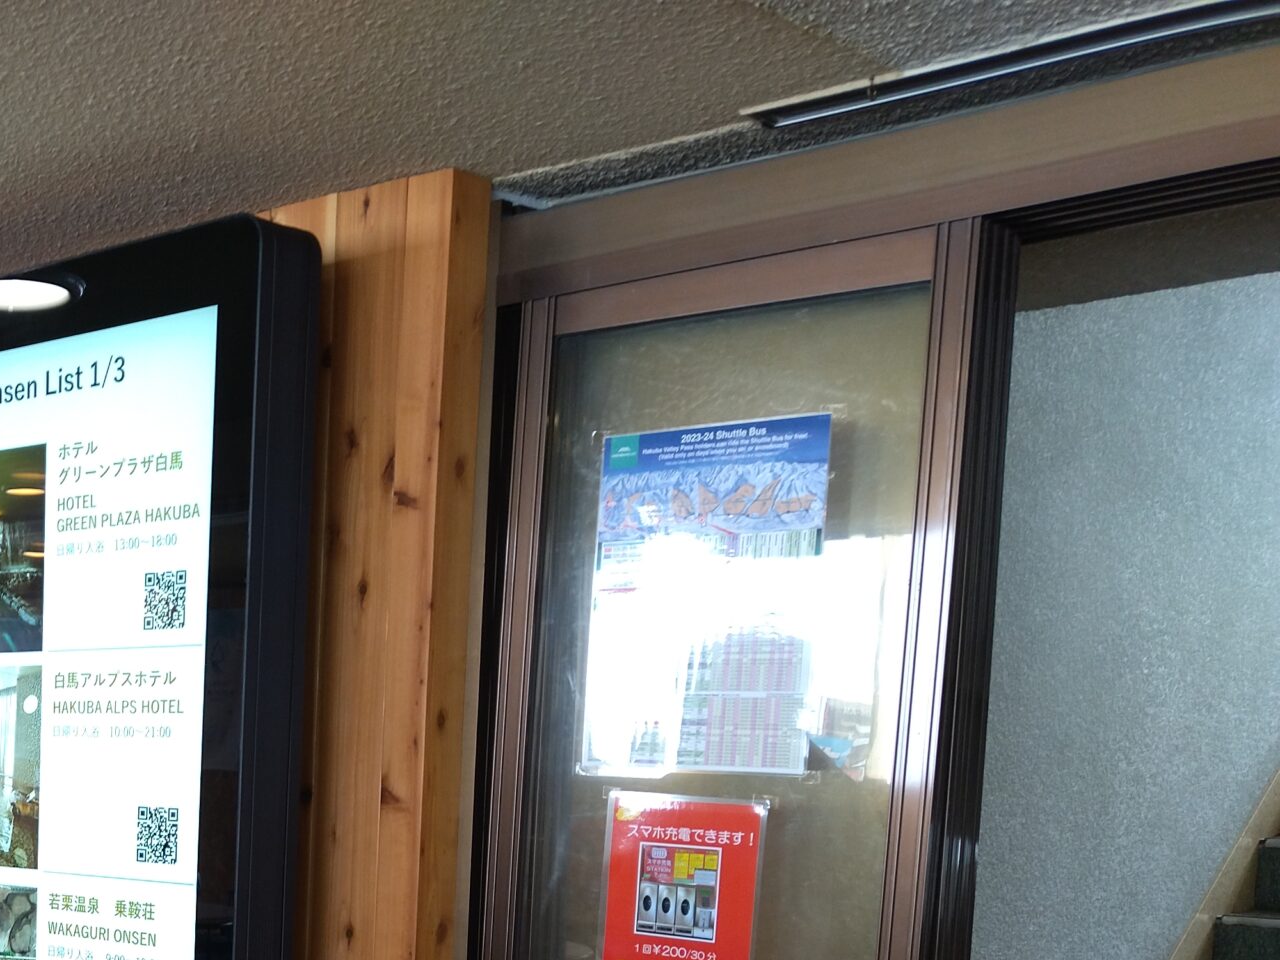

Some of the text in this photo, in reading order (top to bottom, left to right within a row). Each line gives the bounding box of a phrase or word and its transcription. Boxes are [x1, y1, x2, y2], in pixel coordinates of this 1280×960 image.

[45, 366, 83, 396] List
[90, 355, 125, 389] 1/3
[716, 428, 746, 440] Shuttle
[749, 427, 767, 436] Bus
[58, 440, 98, 460] ホテル
[59, 451, 183, 485] グリーンプラザ白馬
[57, 494, 96, 512] HOTEL
[57, 503, 200, 532] GREEN PLAZA HAKUBA
[54, 670, 176, 689] 白馬アルプスホテル
[53, 700, 184, 714] HAKUBA ALPS HOTEL
[49, 893, 155, 920] 若栗温泉 乗鞍荘
[48, 921, 156, 947] WAKAGURI ONSEN
